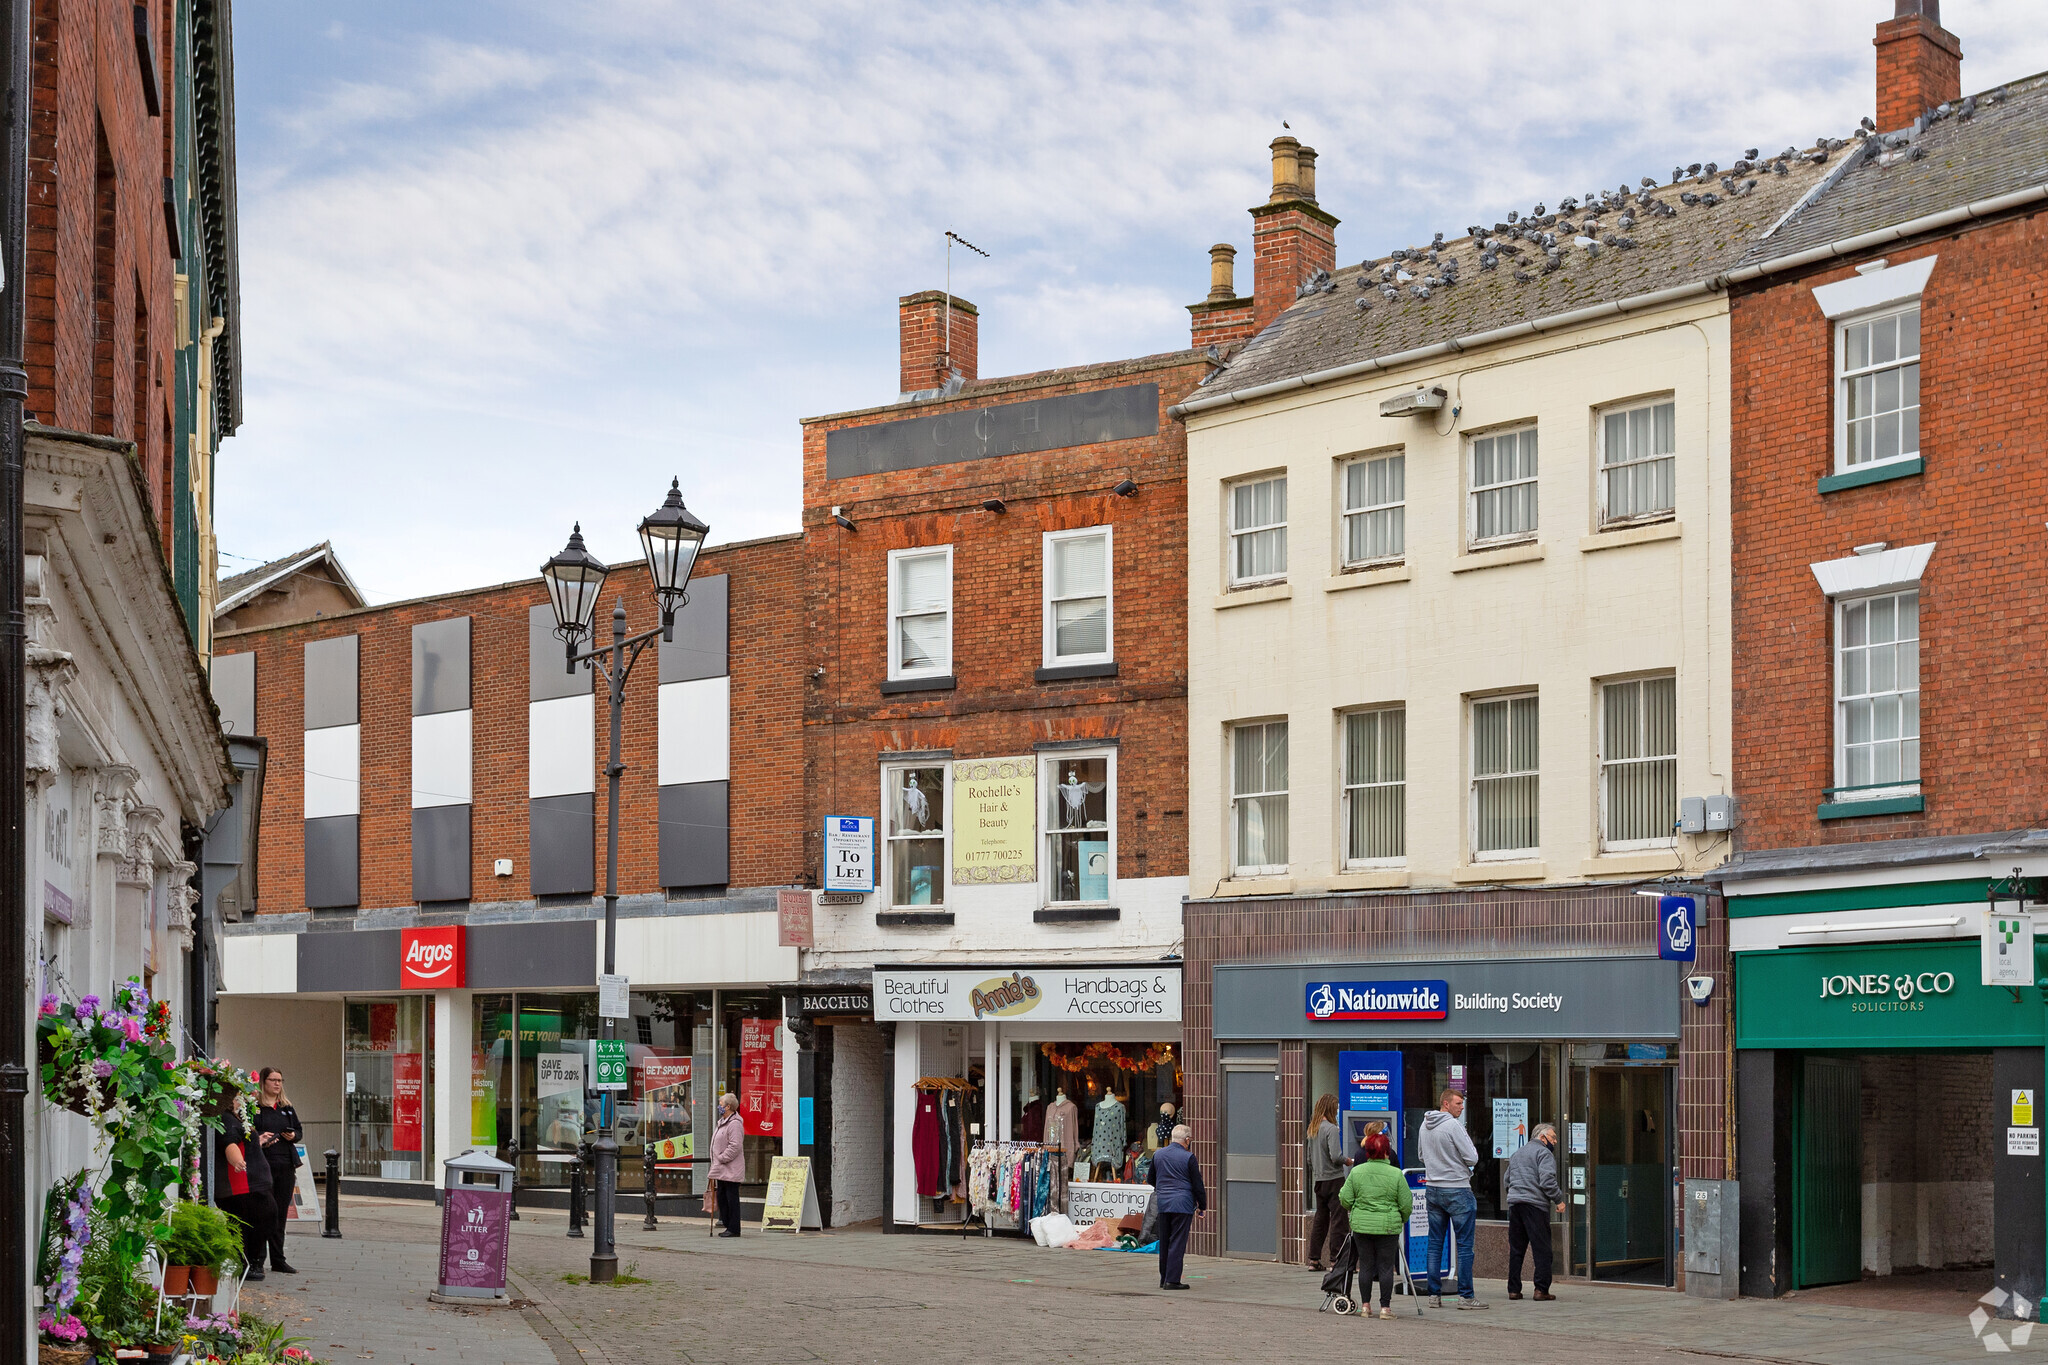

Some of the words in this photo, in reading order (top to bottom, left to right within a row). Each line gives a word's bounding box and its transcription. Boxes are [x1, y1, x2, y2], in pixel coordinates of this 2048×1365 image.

[968, 785, 1021, 799] Rochelle's
[979, 803, 998, 813] Hair
[1000, 802, 1008, 812] &
[979, 818, 1009, 829] Beauty
[965, 851, 991, 861] 01777
[994, 849, 1023, 860] 700225
[783, 894, 808, 904] HONEY
[820, 895, 860, 903] CHURCHGATE
[783, 906, 789, 915] &
[791, 906, 809, 916] LACE
[405, 939, 453, 969] Argos
[1999, 957, 2012, 966] local
[1999, 969, 2018, 978] agency
[1065, 977, 1148, 998] Handbags
[1153, 976, 1167, 994] &
[1820, 974, 1891, 998] JONES
[1894, 974, 1914, 1000] &
[1916, 971, 1955, 994] CO
[885, 979, 949, 995] Beautiful
[972, 972, 1038, 1020] Annie's
[1338, 987, 1440, 1011] Nationwide
[1454, 993, 1508, 1013] Building
[1512, 992, 1563, 1012] Society
[803, 996, 869, 1010] BACCHUS
[889, 998, 945, 1014] Clothes
[1067, 998, 1163, 1014] Accessories
[1852, 1001, 1924, 1012] SOLICITORS
[498, 1029, 535, 1041] CRATE
[537, 1031, 560, 1042] YOUR
[744, 1041, 767, 1049] SPREAD
[541, 1059, 561, 1070] SAVE
[646, 1065, 661, 1075] GET
[662, 1065, 690, 1075] SPOOKY
[541, 1069, 552, 1080] UP
[553, 1070, 563, 1080] TO
[564, 1070, 579, 1081] 20%
[474, 1079, 494, 1090] History
[1068, 1190, 1096, 1203] Italian
[1101, 1191, 1145, 1208] Clothing
[1074, 1205, 1114, 1218] Scarves
[461, 1225, 488, 1233] LITTER
[502, 1200, 510, 1258] NOTTINGHAMSHIRE
